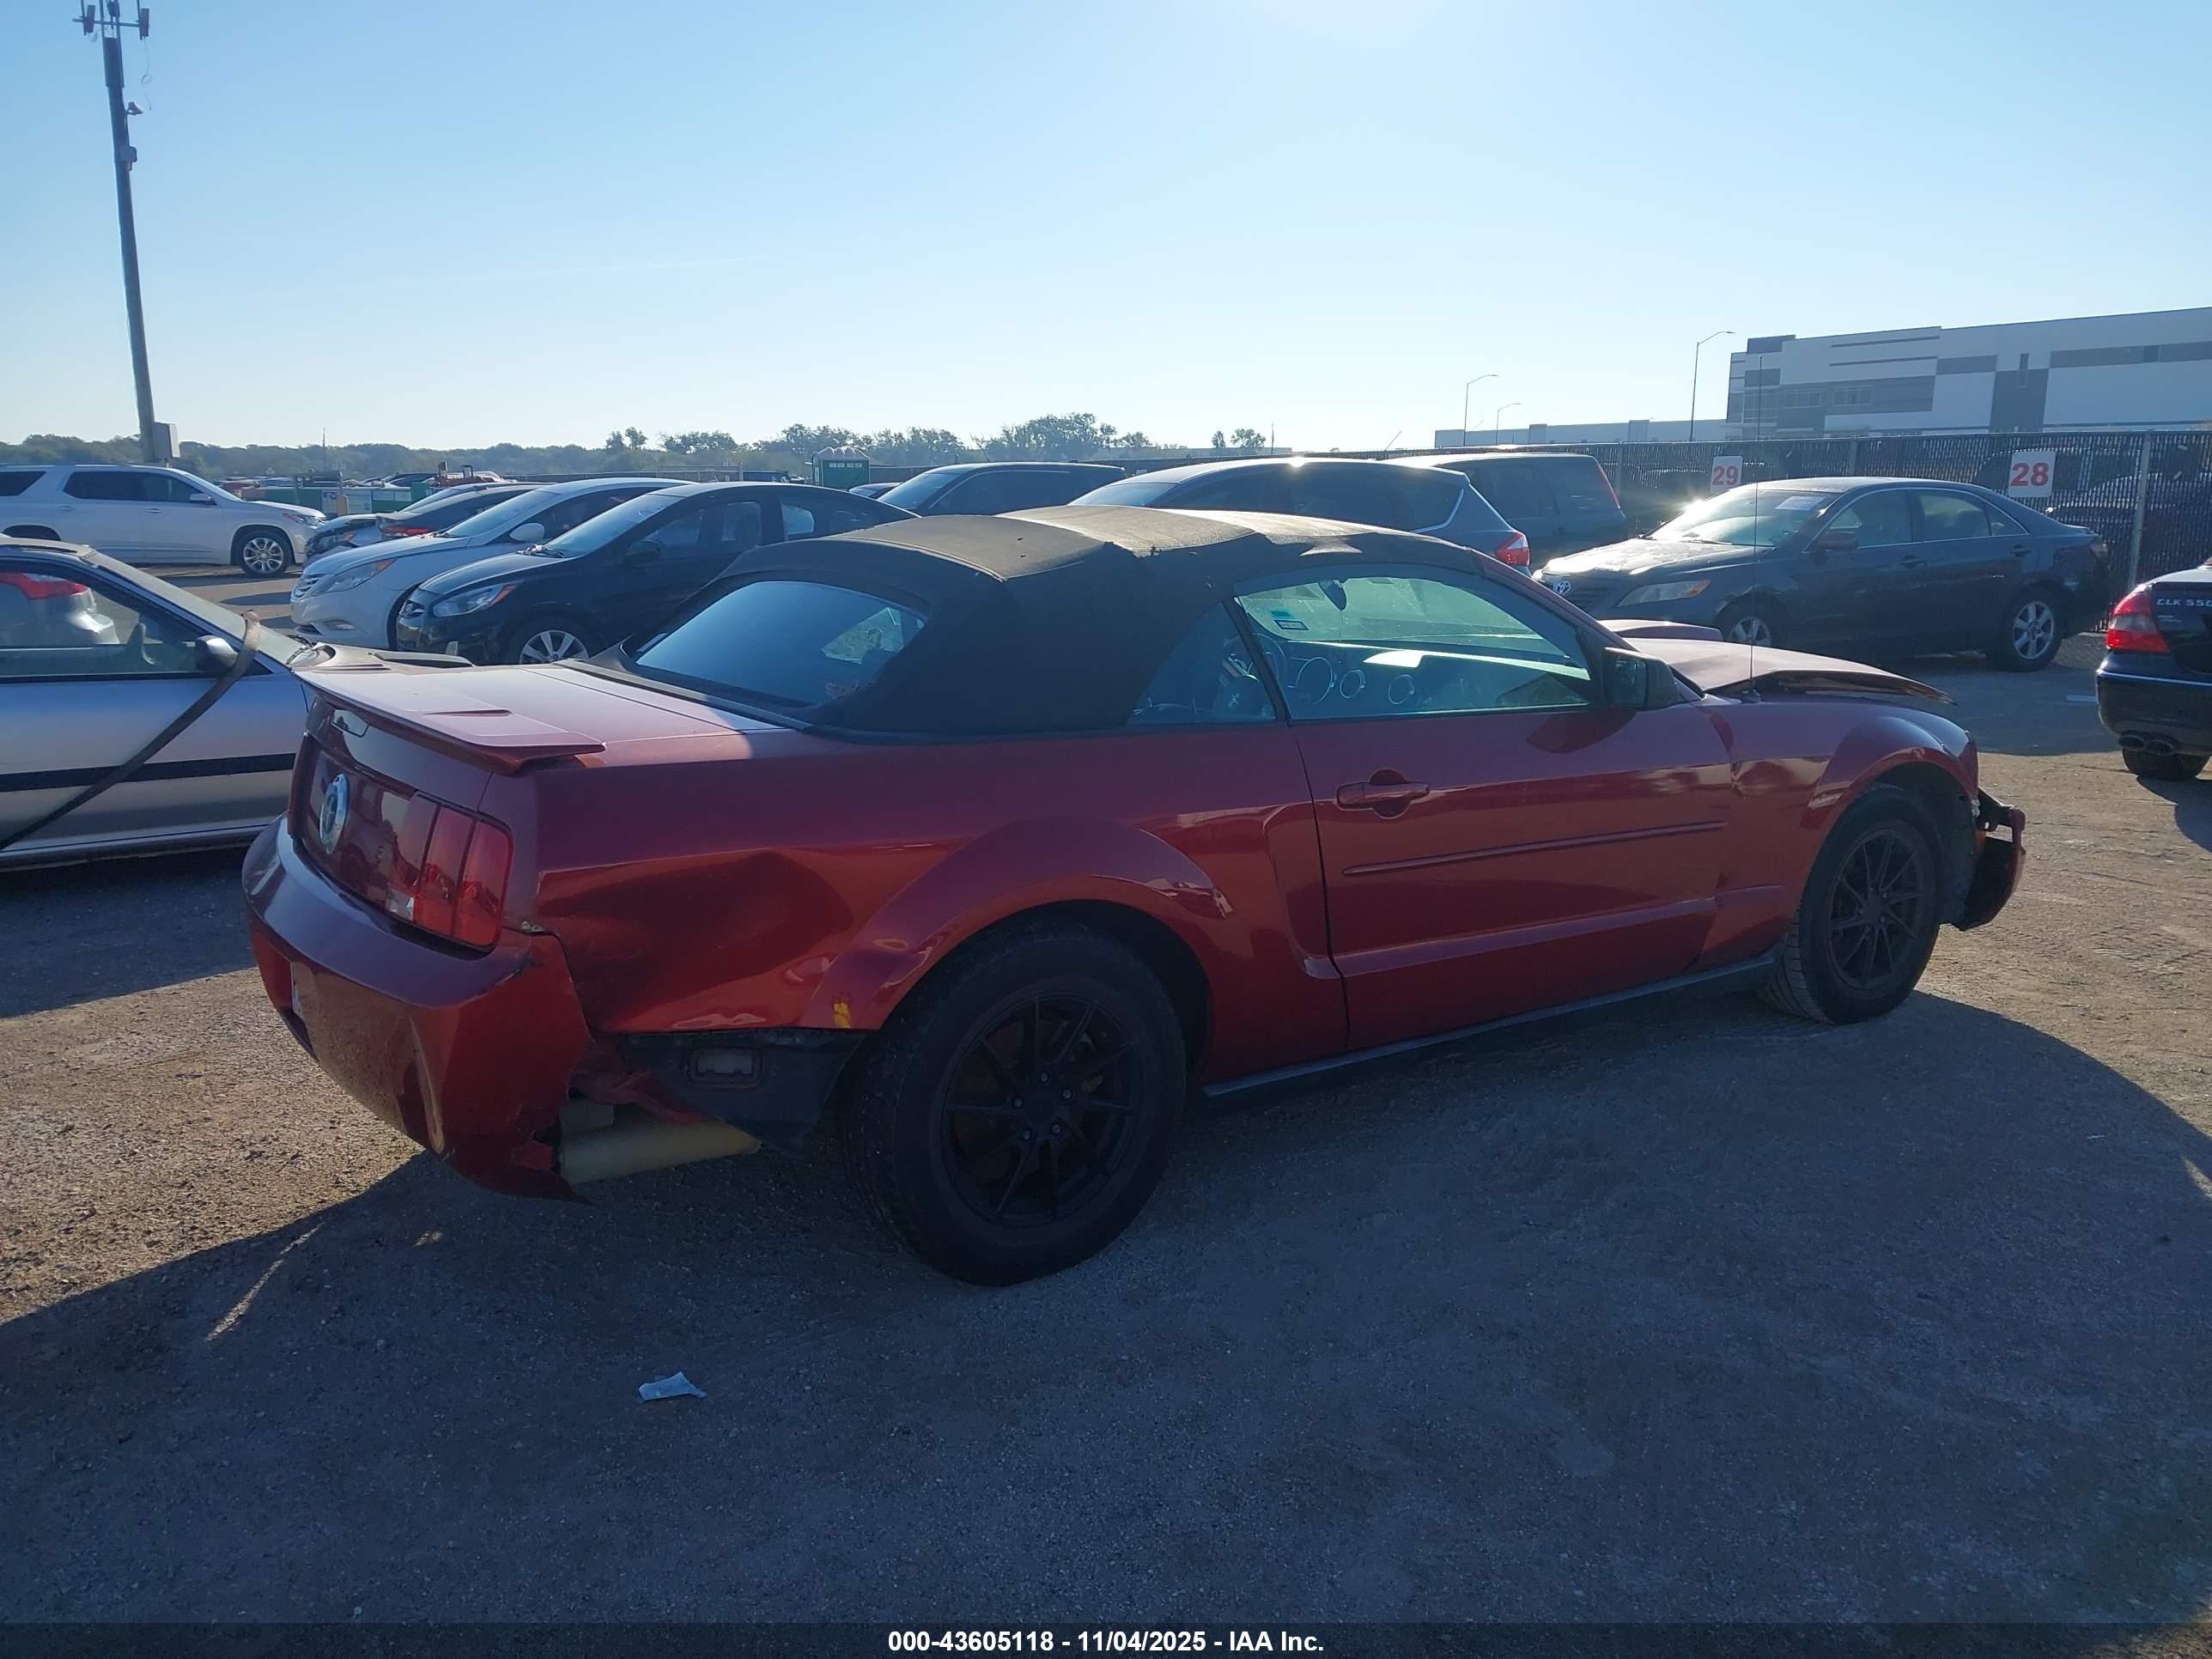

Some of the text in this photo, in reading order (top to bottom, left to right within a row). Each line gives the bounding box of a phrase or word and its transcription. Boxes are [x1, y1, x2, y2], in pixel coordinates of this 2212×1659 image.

[1712, 465, 1739, 486] 29
[2010, 462, 2049, 487] 28
[2156, 598, 2182, 606] CLK
